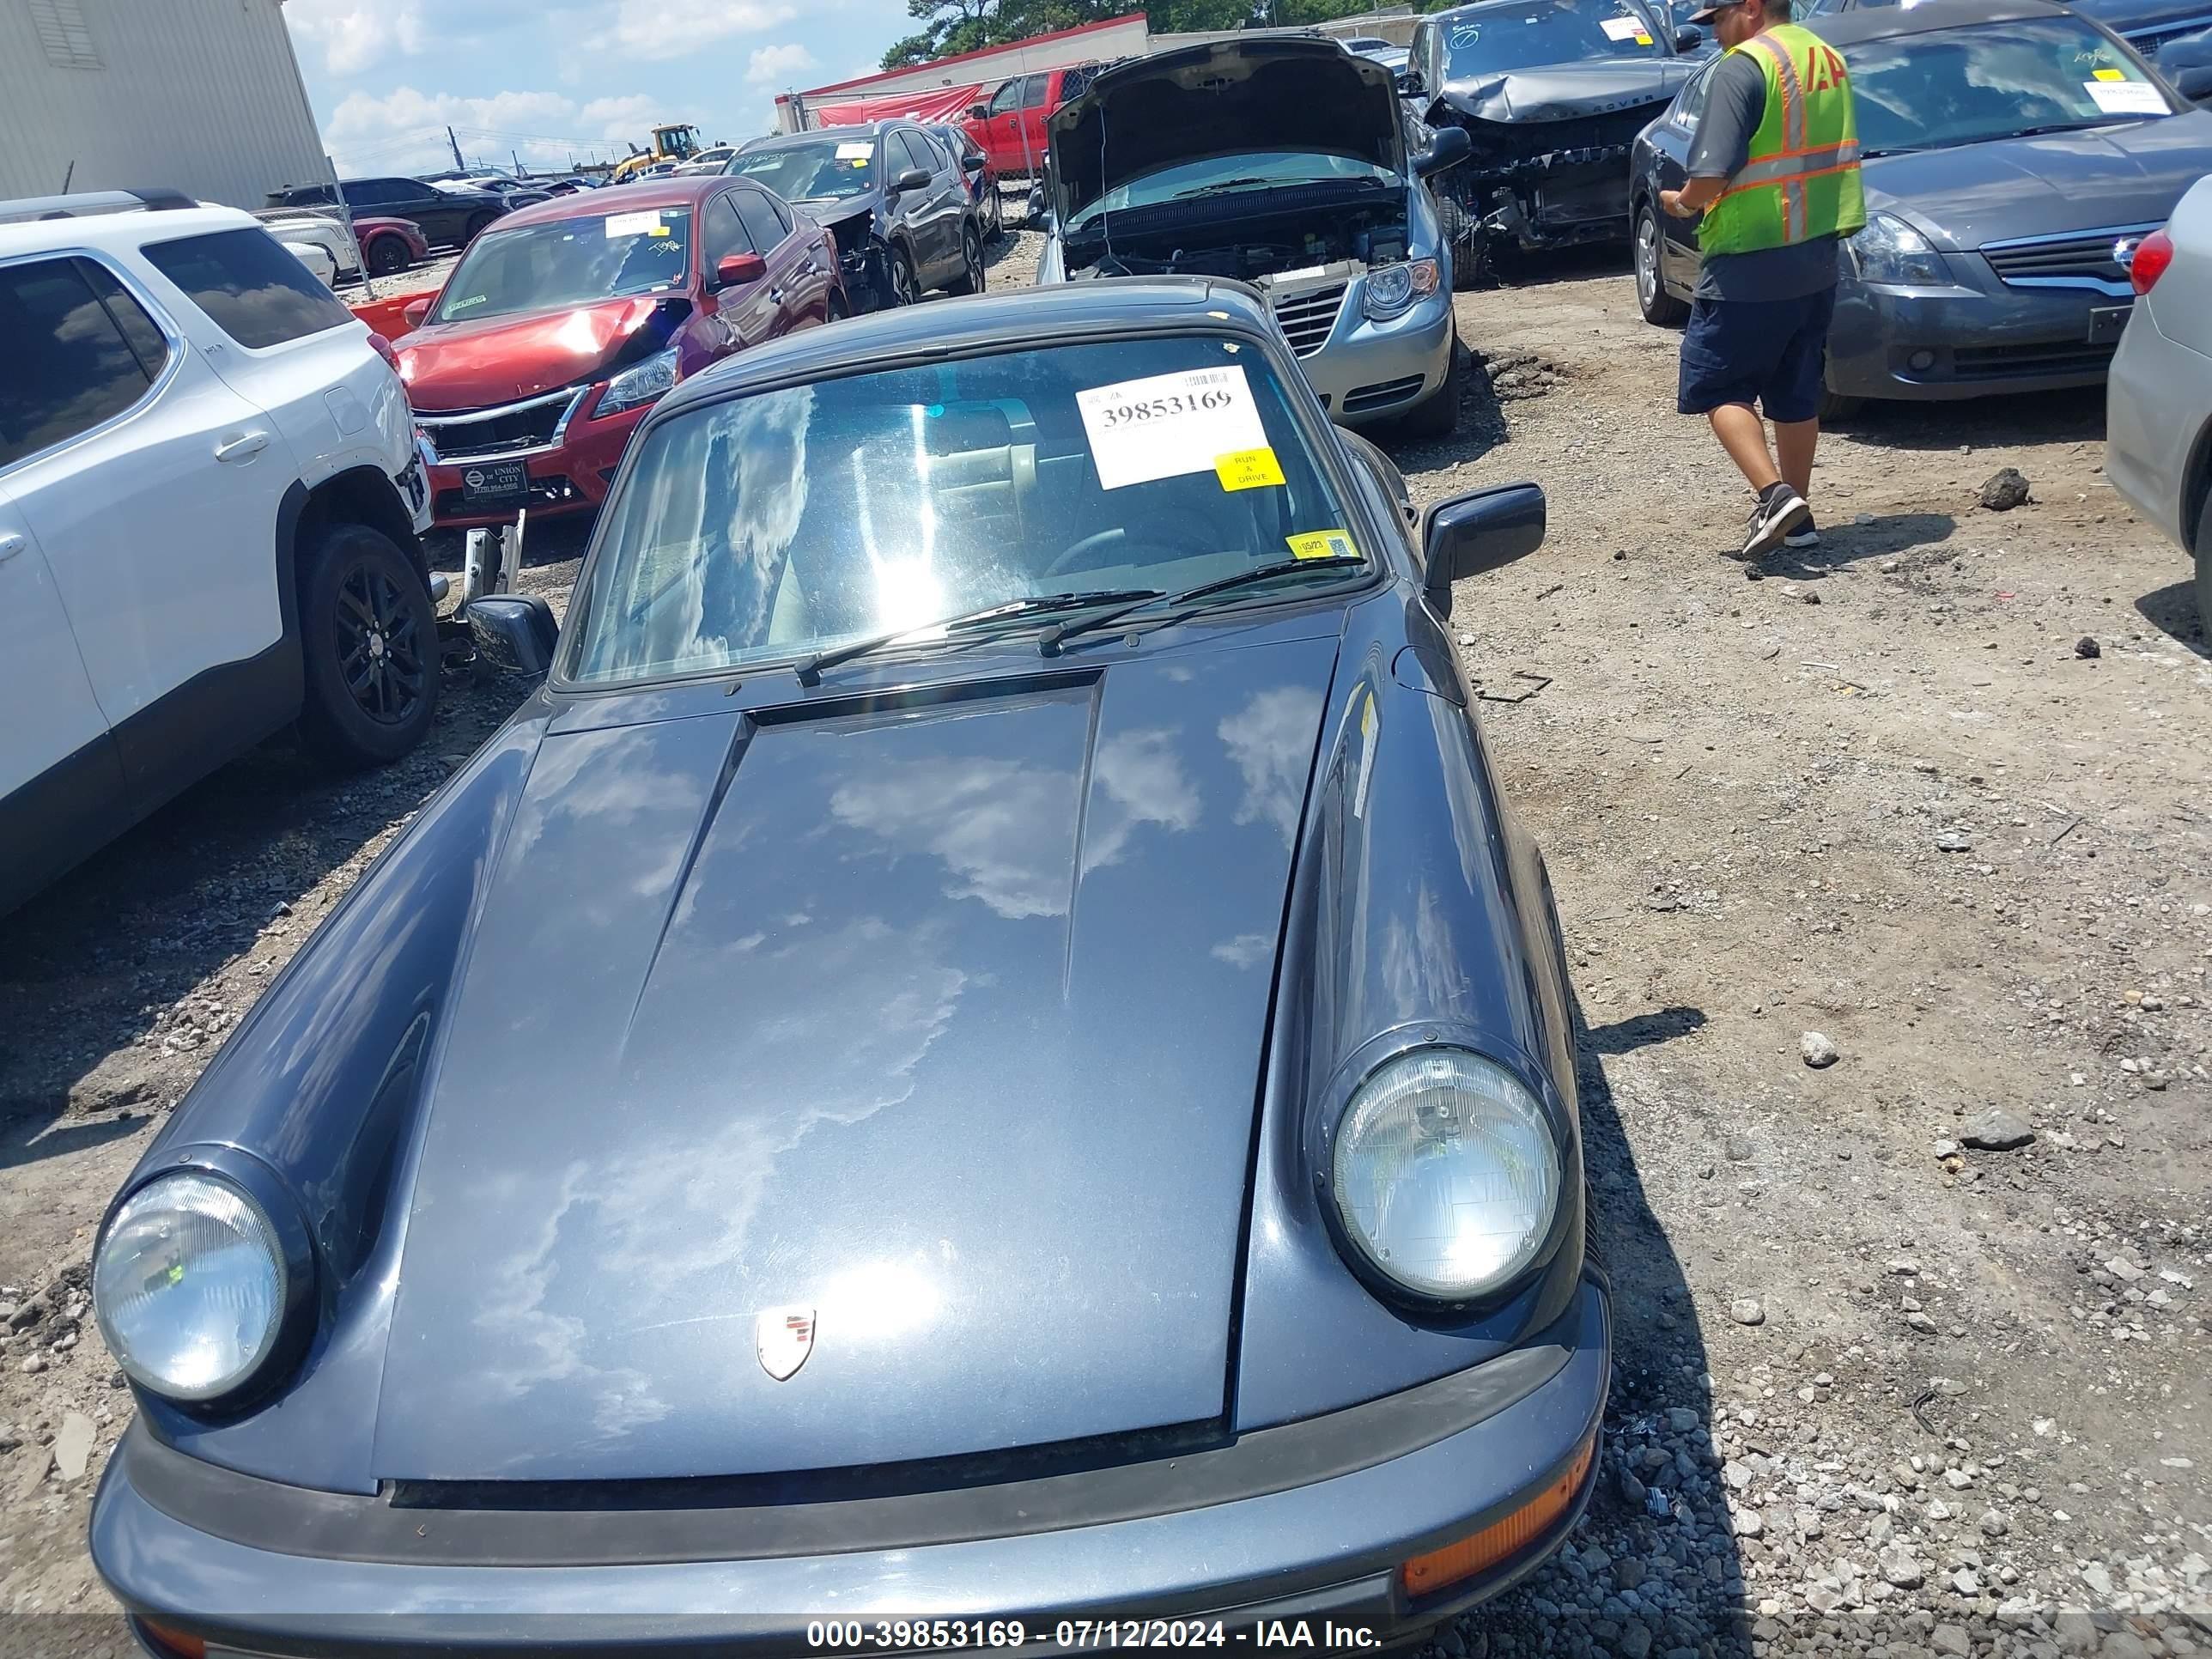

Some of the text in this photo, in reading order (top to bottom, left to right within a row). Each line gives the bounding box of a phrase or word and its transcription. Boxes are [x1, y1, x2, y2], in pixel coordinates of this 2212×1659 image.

[1807, 45, 1846, 93] IAA
[1593, 94, 1655, 112] ROVER
[1103, 389, 1232, 428] 39853169
[1234, 455, 1257, 465] RUN
[494, 465, 521, 476] UNION
[499, 474, 519, 483] CITY
[1237, 472, 1269, 483] DRIVE
[1302, 539, 1324, 551] 05/23
